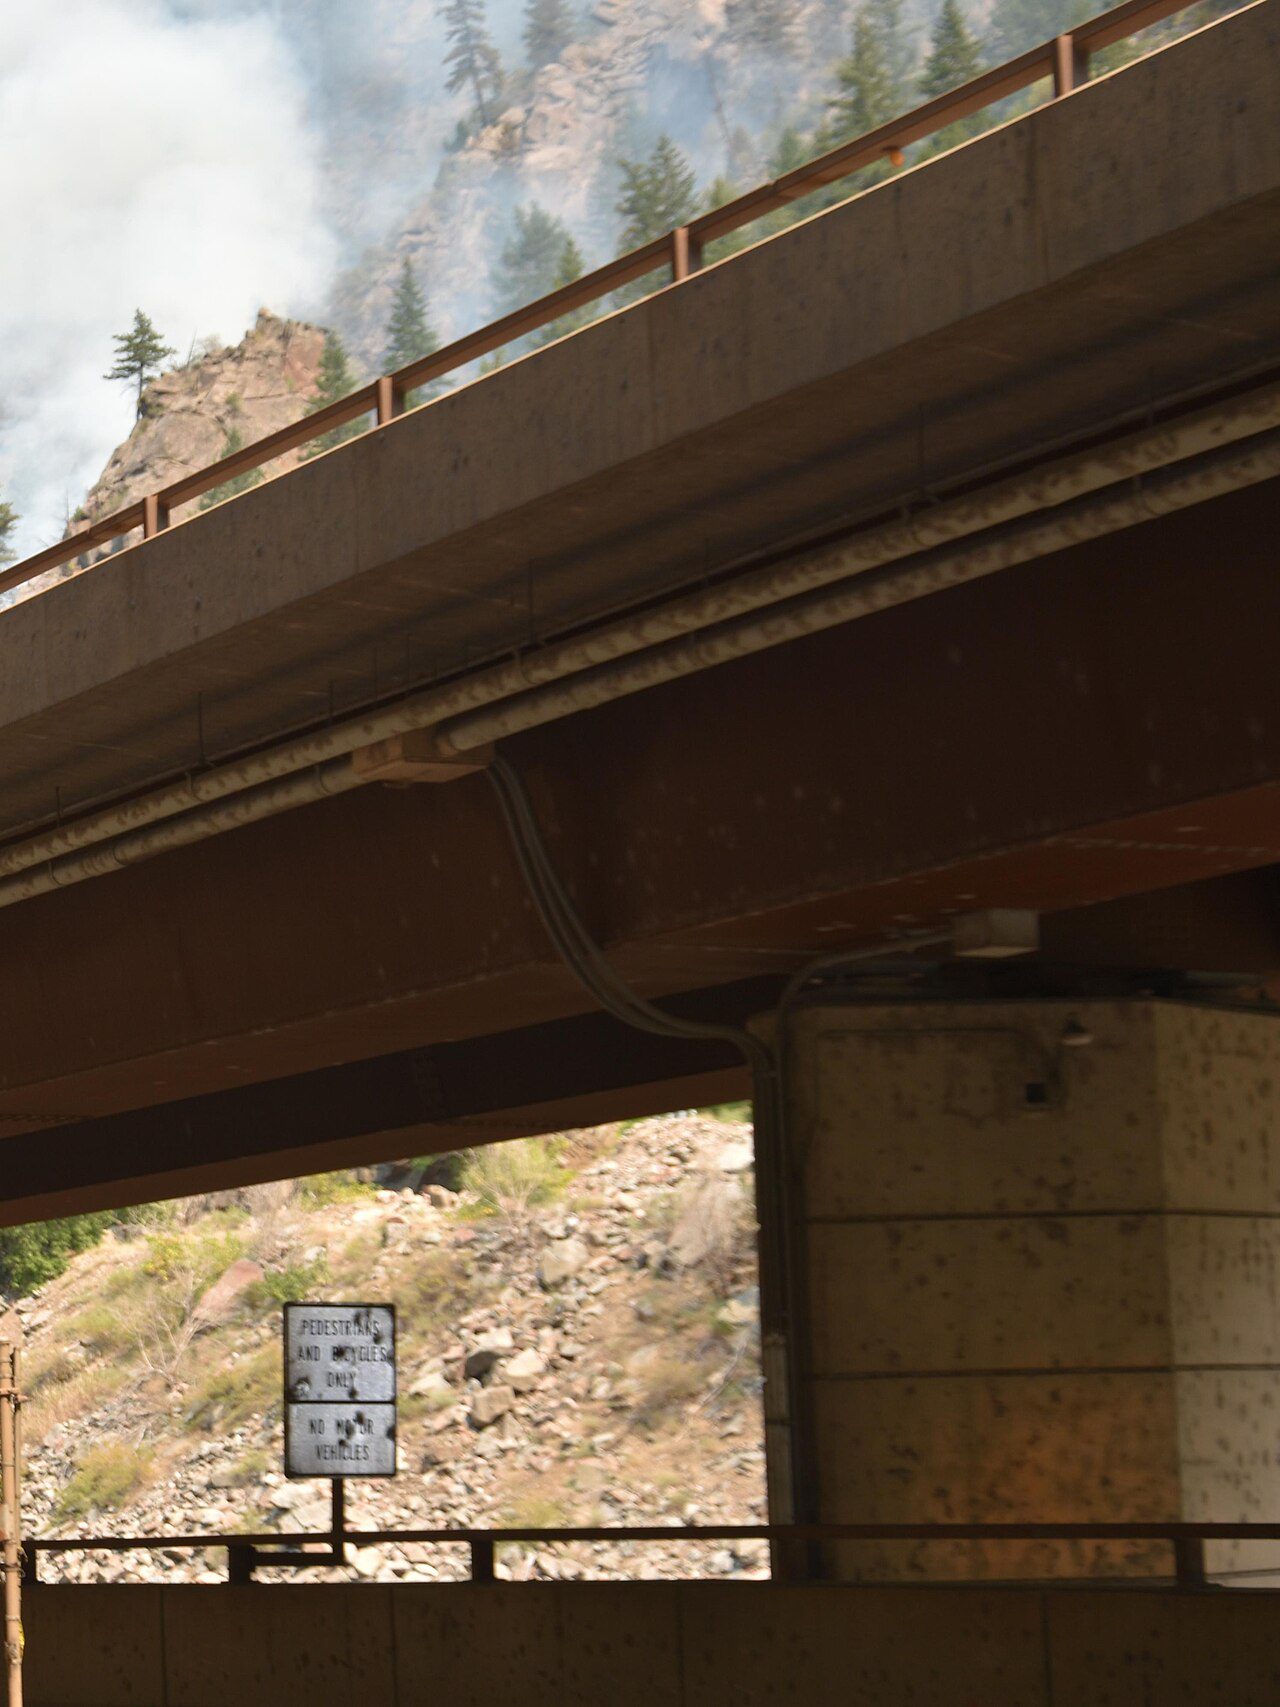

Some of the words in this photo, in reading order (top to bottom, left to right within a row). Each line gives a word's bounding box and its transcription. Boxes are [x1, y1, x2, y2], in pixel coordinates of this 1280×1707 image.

[301, 1319, 380, 1336] PEDESTRIANS
[298, 1345, 321, 1361] AND
[327, 1371, 357, 1388] ONLY
[309, 1418, 325, 1434] NO
[335, 1418, 374, 1435] MOOR
[315, 1444, 370, 1460] VEHICLES
